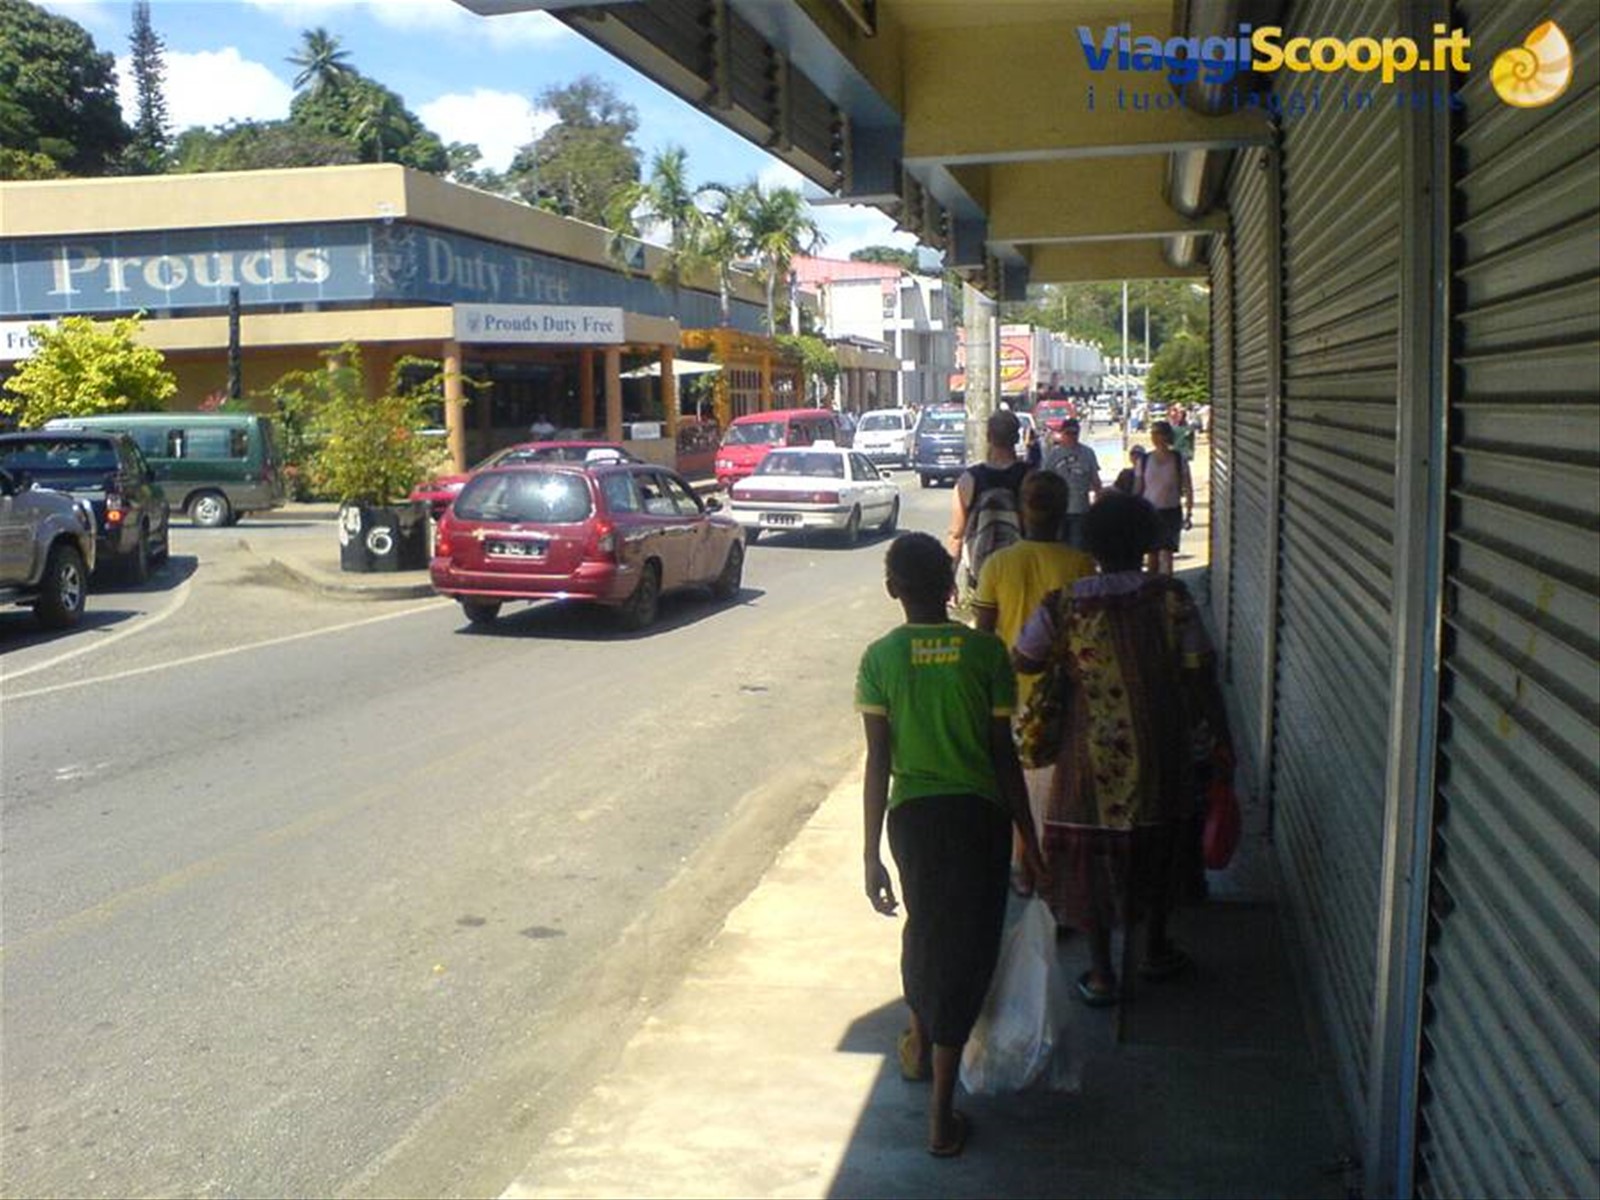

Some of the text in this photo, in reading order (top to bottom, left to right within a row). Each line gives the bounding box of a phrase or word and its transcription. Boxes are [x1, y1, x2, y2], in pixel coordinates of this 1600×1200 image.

[47, 236, 569, 303] Prouds Duty Free
[484, 314, 614, 336] Prouds Duty Free
